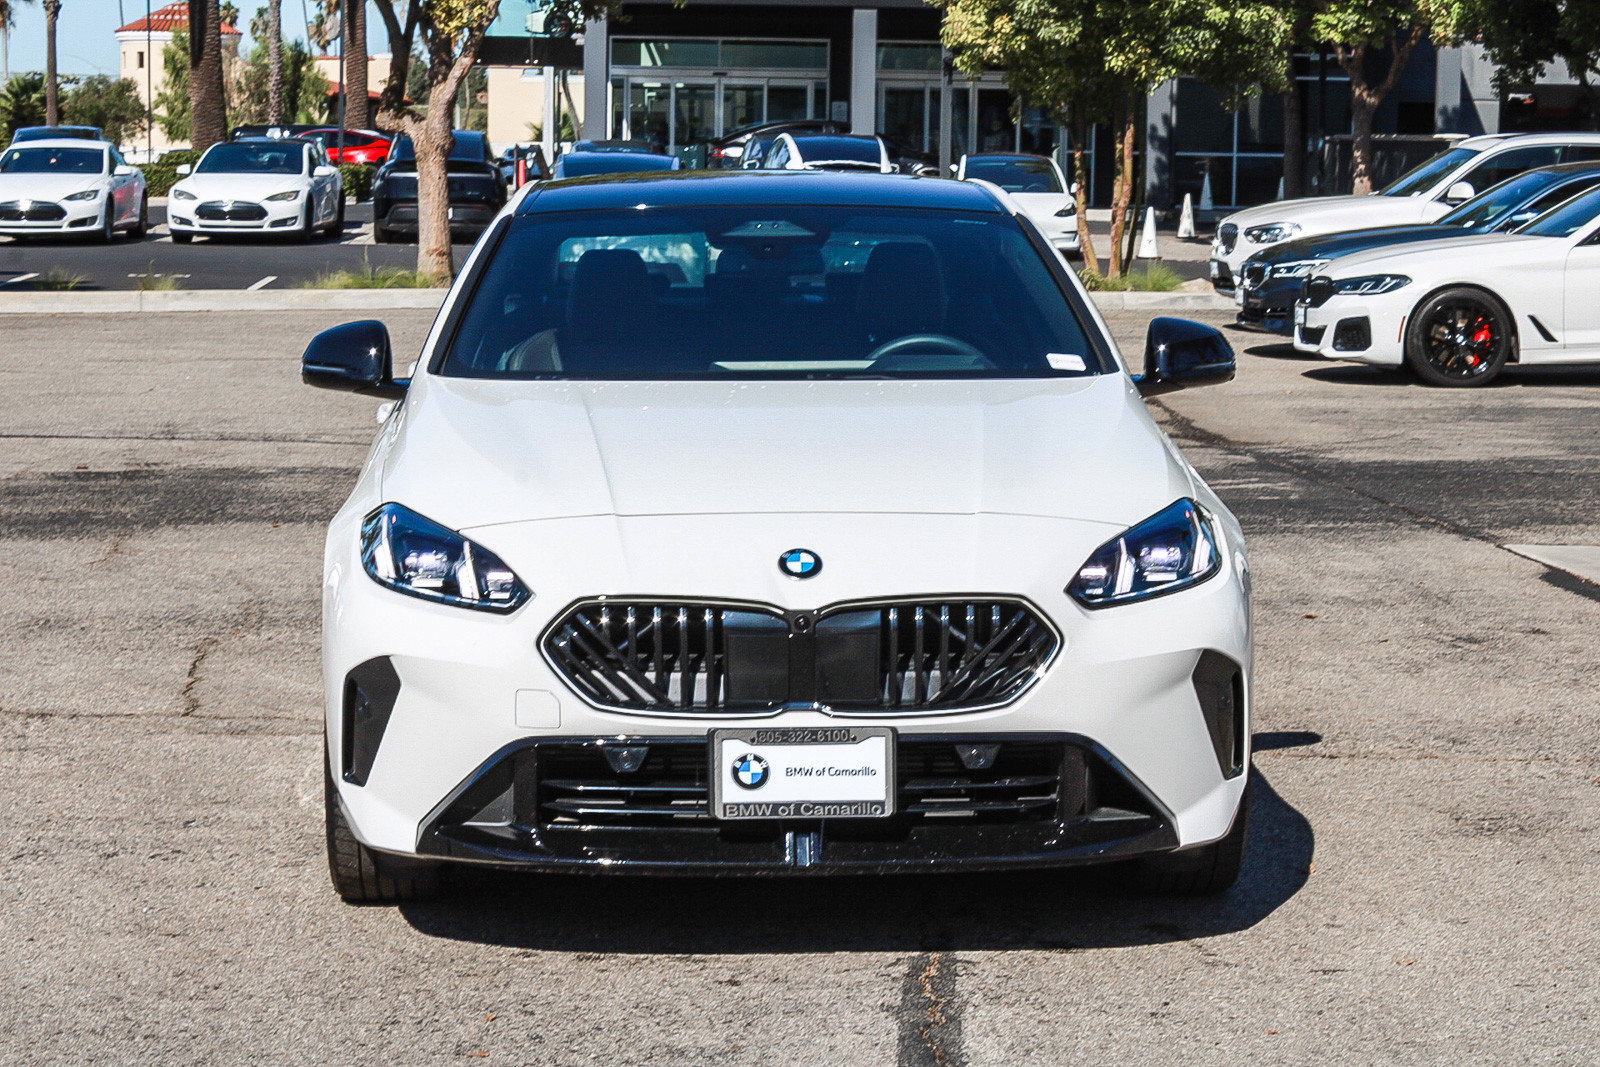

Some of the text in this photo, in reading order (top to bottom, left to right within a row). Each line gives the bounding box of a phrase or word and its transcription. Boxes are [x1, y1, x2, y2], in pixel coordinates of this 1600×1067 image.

[758, 730, 849, 743] 805-322-6100
[785, 766, 877, 777] BMW of Camarillo
[725, 802, 883, 817] BMW of Camarillo
